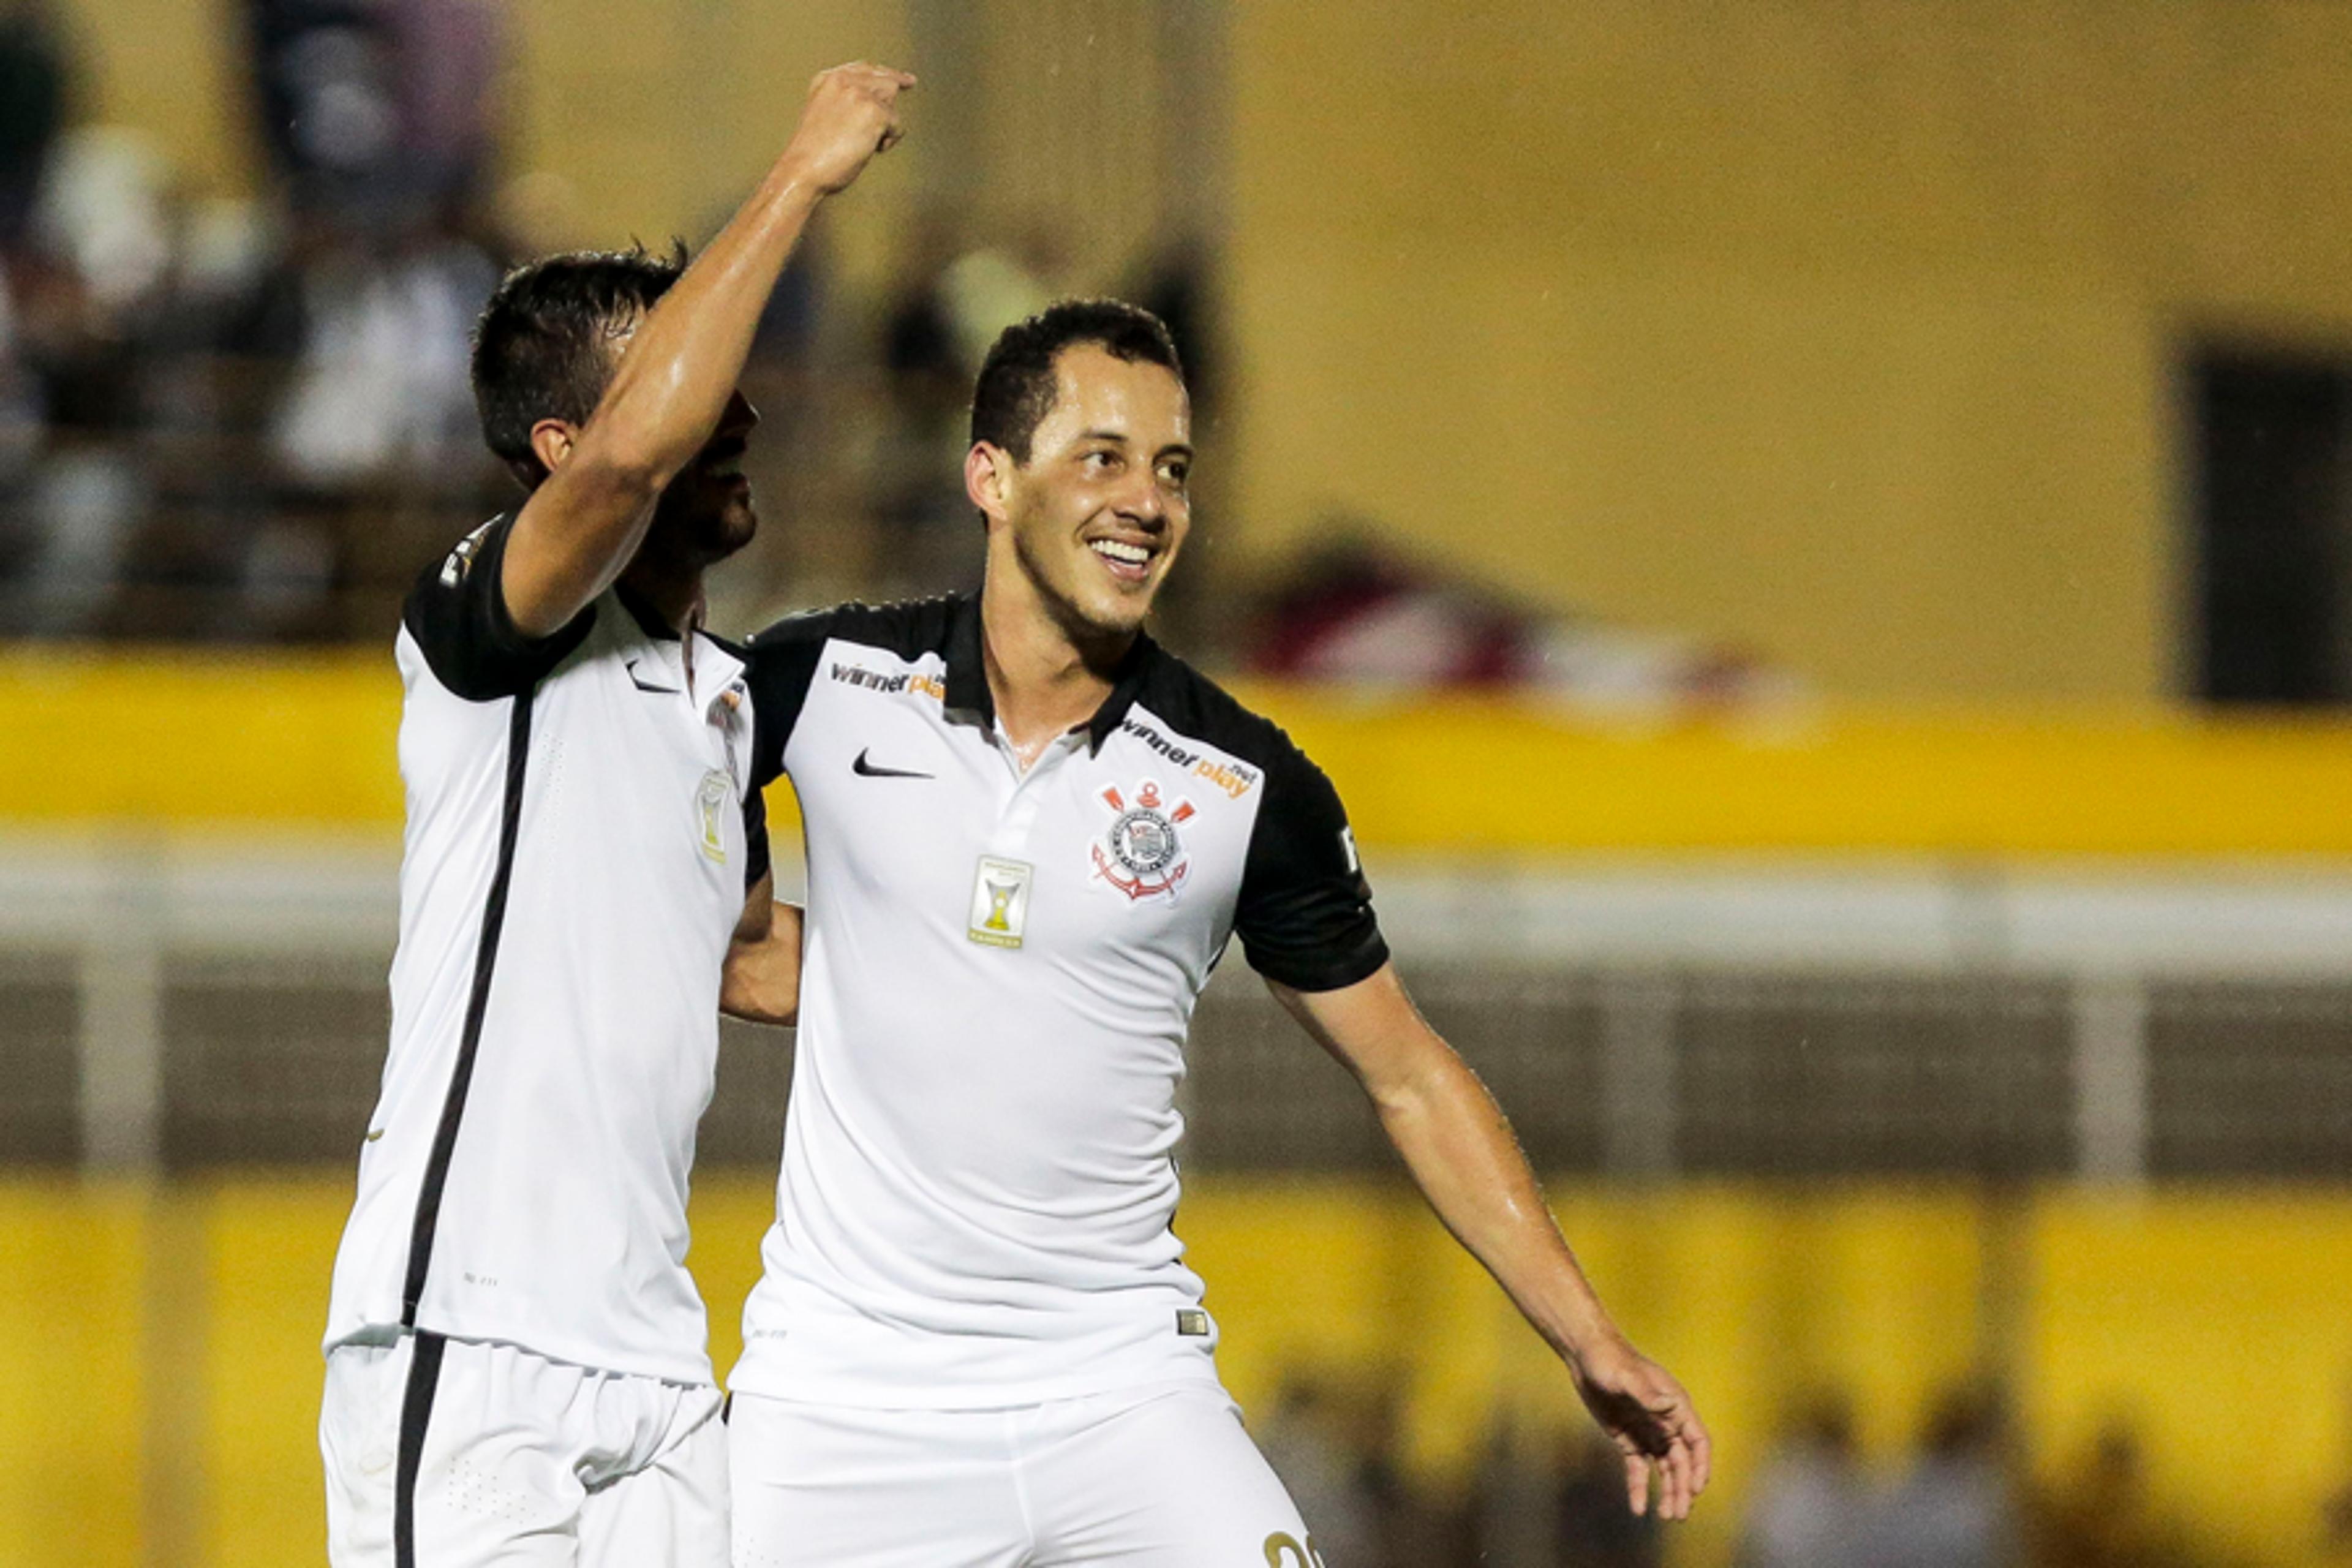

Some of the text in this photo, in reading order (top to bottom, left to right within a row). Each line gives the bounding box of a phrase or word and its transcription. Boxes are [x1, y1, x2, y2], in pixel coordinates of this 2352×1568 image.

[832, 663, 946, 701] winner pla
[1192, 760, 1250, 799] play
